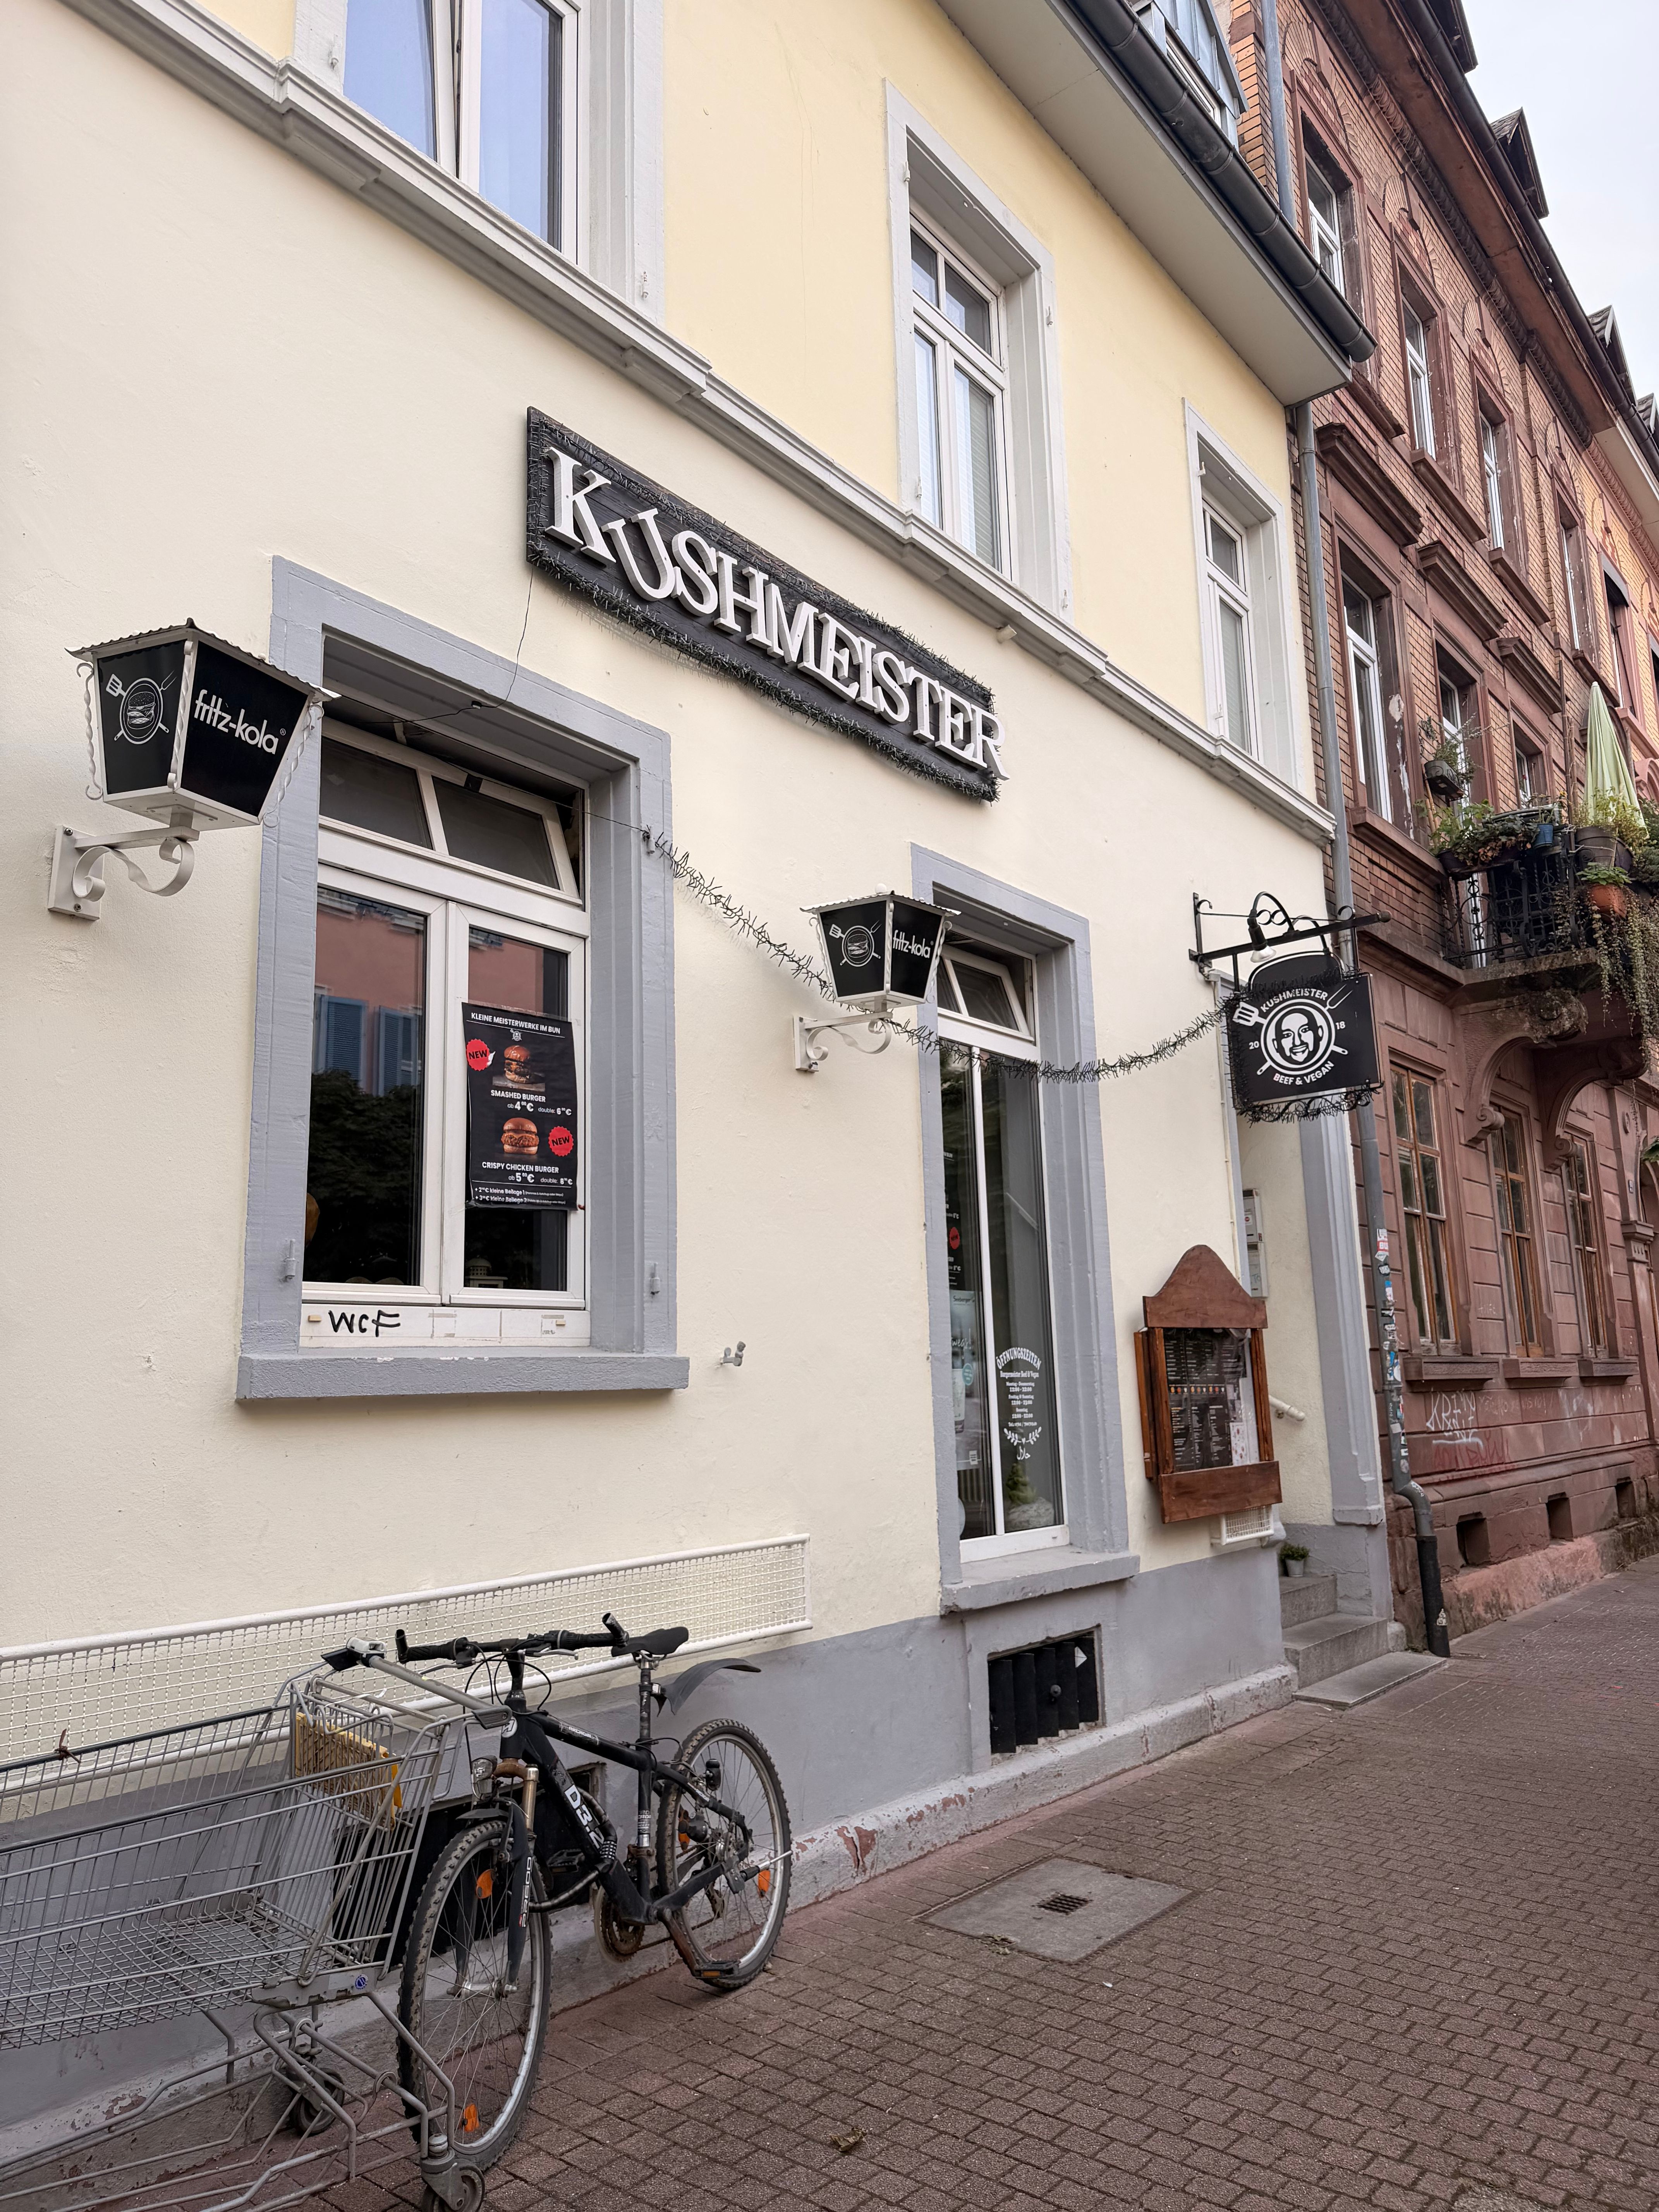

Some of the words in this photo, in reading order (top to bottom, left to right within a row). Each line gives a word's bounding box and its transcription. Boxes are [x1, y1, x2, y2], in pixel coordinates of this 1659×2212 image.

[545, 447, 1009, 780] KUSHMEISTER
[194, 689, 278, 754] fritz-kola
[893, 930, 931, 958] fritz-kola
[1261, 988, 1328, 1013] KUSHMEISTER
[471, 1012, 492, 1022] KLEINE
[493, 1017, 539, 1030] MEISTERWERKE
[548, 1026, 560, 1034] BUN
[1249, 1041, 1259, 1049] 20
[1335, 1021, 1346, 1030] 18
[468, 1049, 488, 1059] NEW
[1273, 1073, 1293, 1085] BEEF
[1296, 1077, 1303, 1085] &
[1304, 1061, 1334, 1084] VEGAN
[491, 1090, 521, 1101] SMASHED
[522, 1092, 546, 1102] BURGER
[551, 1136, 570, 1147] NEW
[482, 1161, 505, 1170] CRISPY
[506, 1163, 534, 1172] CHICKEN
[535, 1164, 559, 1173] BURGER
[328, 1310, 400, 1337] WCF
[996, 1347, 1041, 1370] ÖFFNUNGSZEITEN
